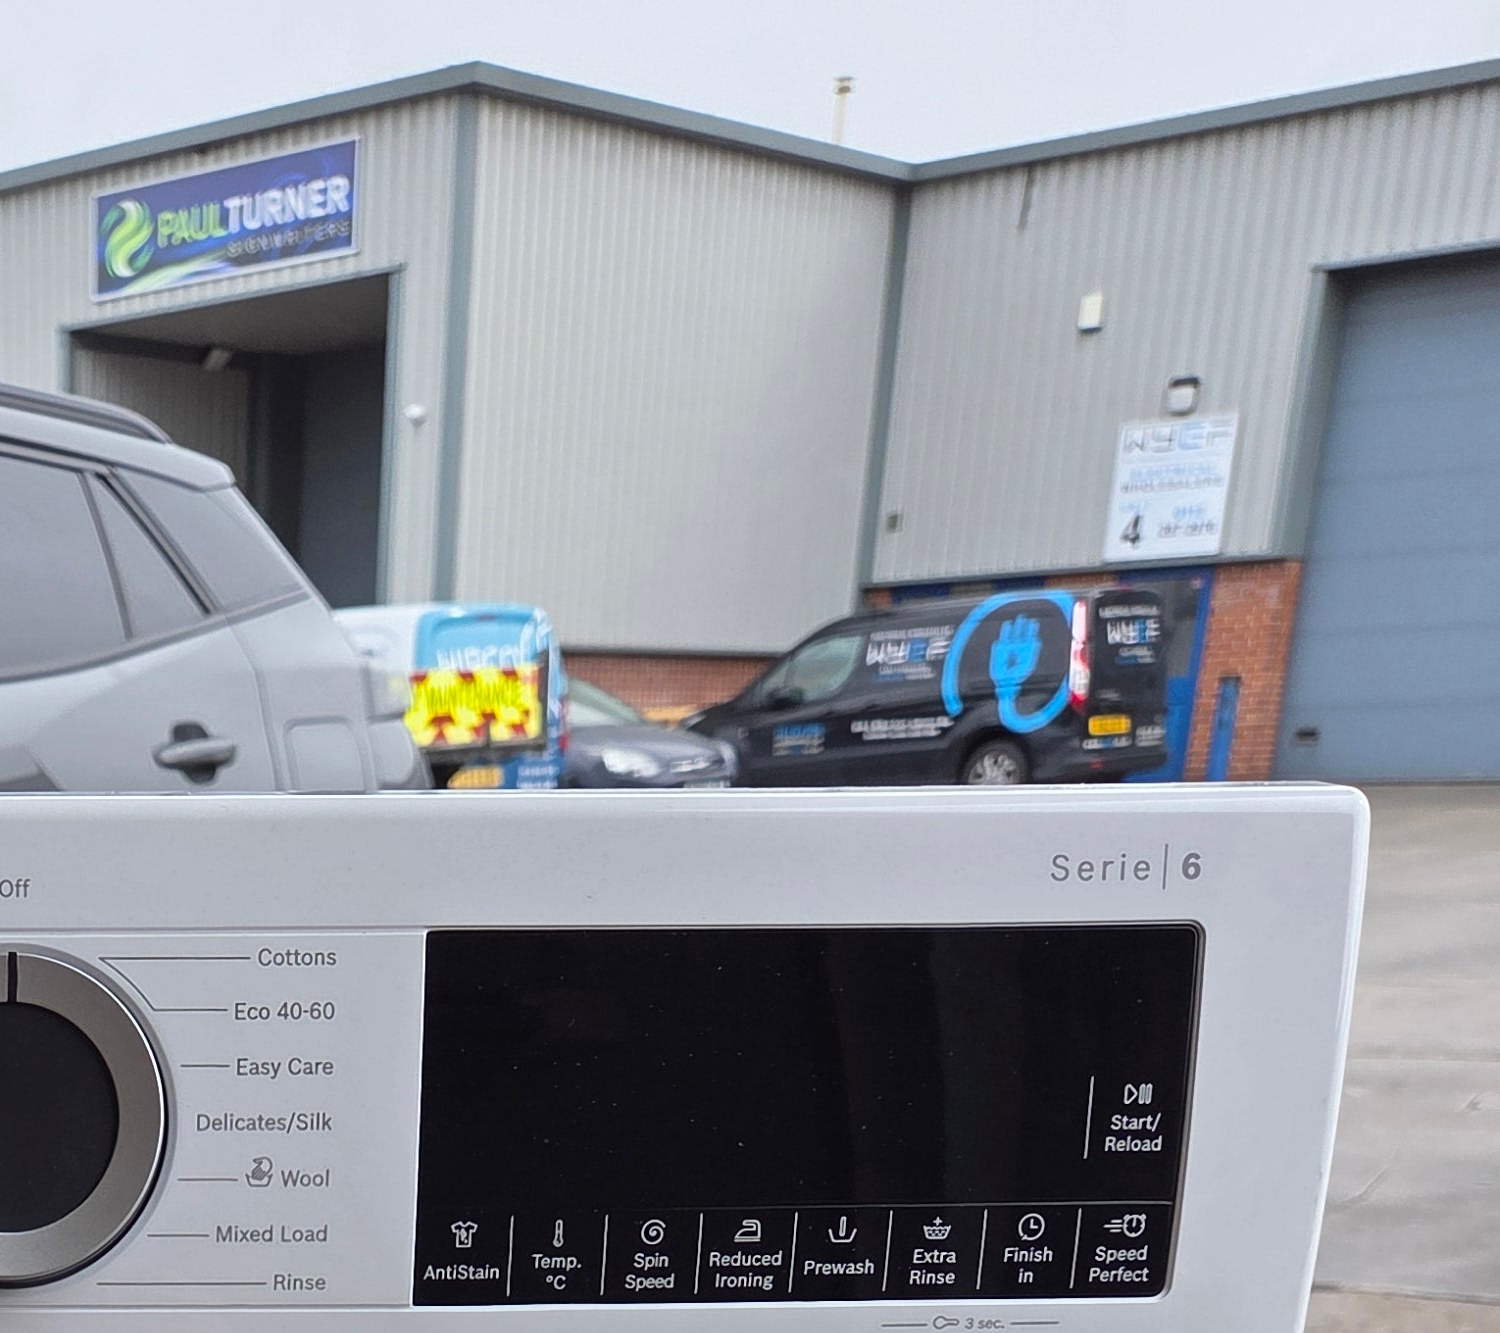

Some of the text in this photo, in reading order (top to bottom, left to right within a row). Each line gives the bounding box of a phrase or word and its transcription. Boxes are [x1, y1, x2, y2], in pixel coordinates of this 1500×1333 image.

[1119, 514, 1143, 547] 4
[1050, 852, 1202, 882] Serie 6
[257, 947, 337, 967] Cottons
[234, 1001, 335, 1021] Eco 40-60
[236, 1057, 334, 1080] Easy Care
[196, 1111, 332, 1134] Delicates/Silk
[1110, 1112, 1162, 1133] Start/
[1104, 1134, 1163, 1152] Reload
[280, 1168, 330, 1188] Wool
[216, 1224, 328, 1243] Mixed Load
[531, 1253, 582, 1272] Temp.
[633, 1252, 669, 1271] Spin
[709, 1250, 783, 1268] Reduced
[912, 1248, 957, 1264] Extra
[1003, 1245, 1054, 1263] Finish
[1094, 1244, 1149, 1265] Speed
[423, 1263, 500, 1280] AntiStain
[803, 1258, 875, 1276] Prewash
[1018, 1268, 1034, 1284] in
[1088, 1266, 1150, 1283] Perfect
[273, 1273, 326, 1291] Rinse
[624, 1272, 675, 1292] Speed
[715, 1272, 774, 1291] Ironing
[909, 1269, 956, 1285] Rinse
[964, 1317, 1006, 1330] 3 sec.
